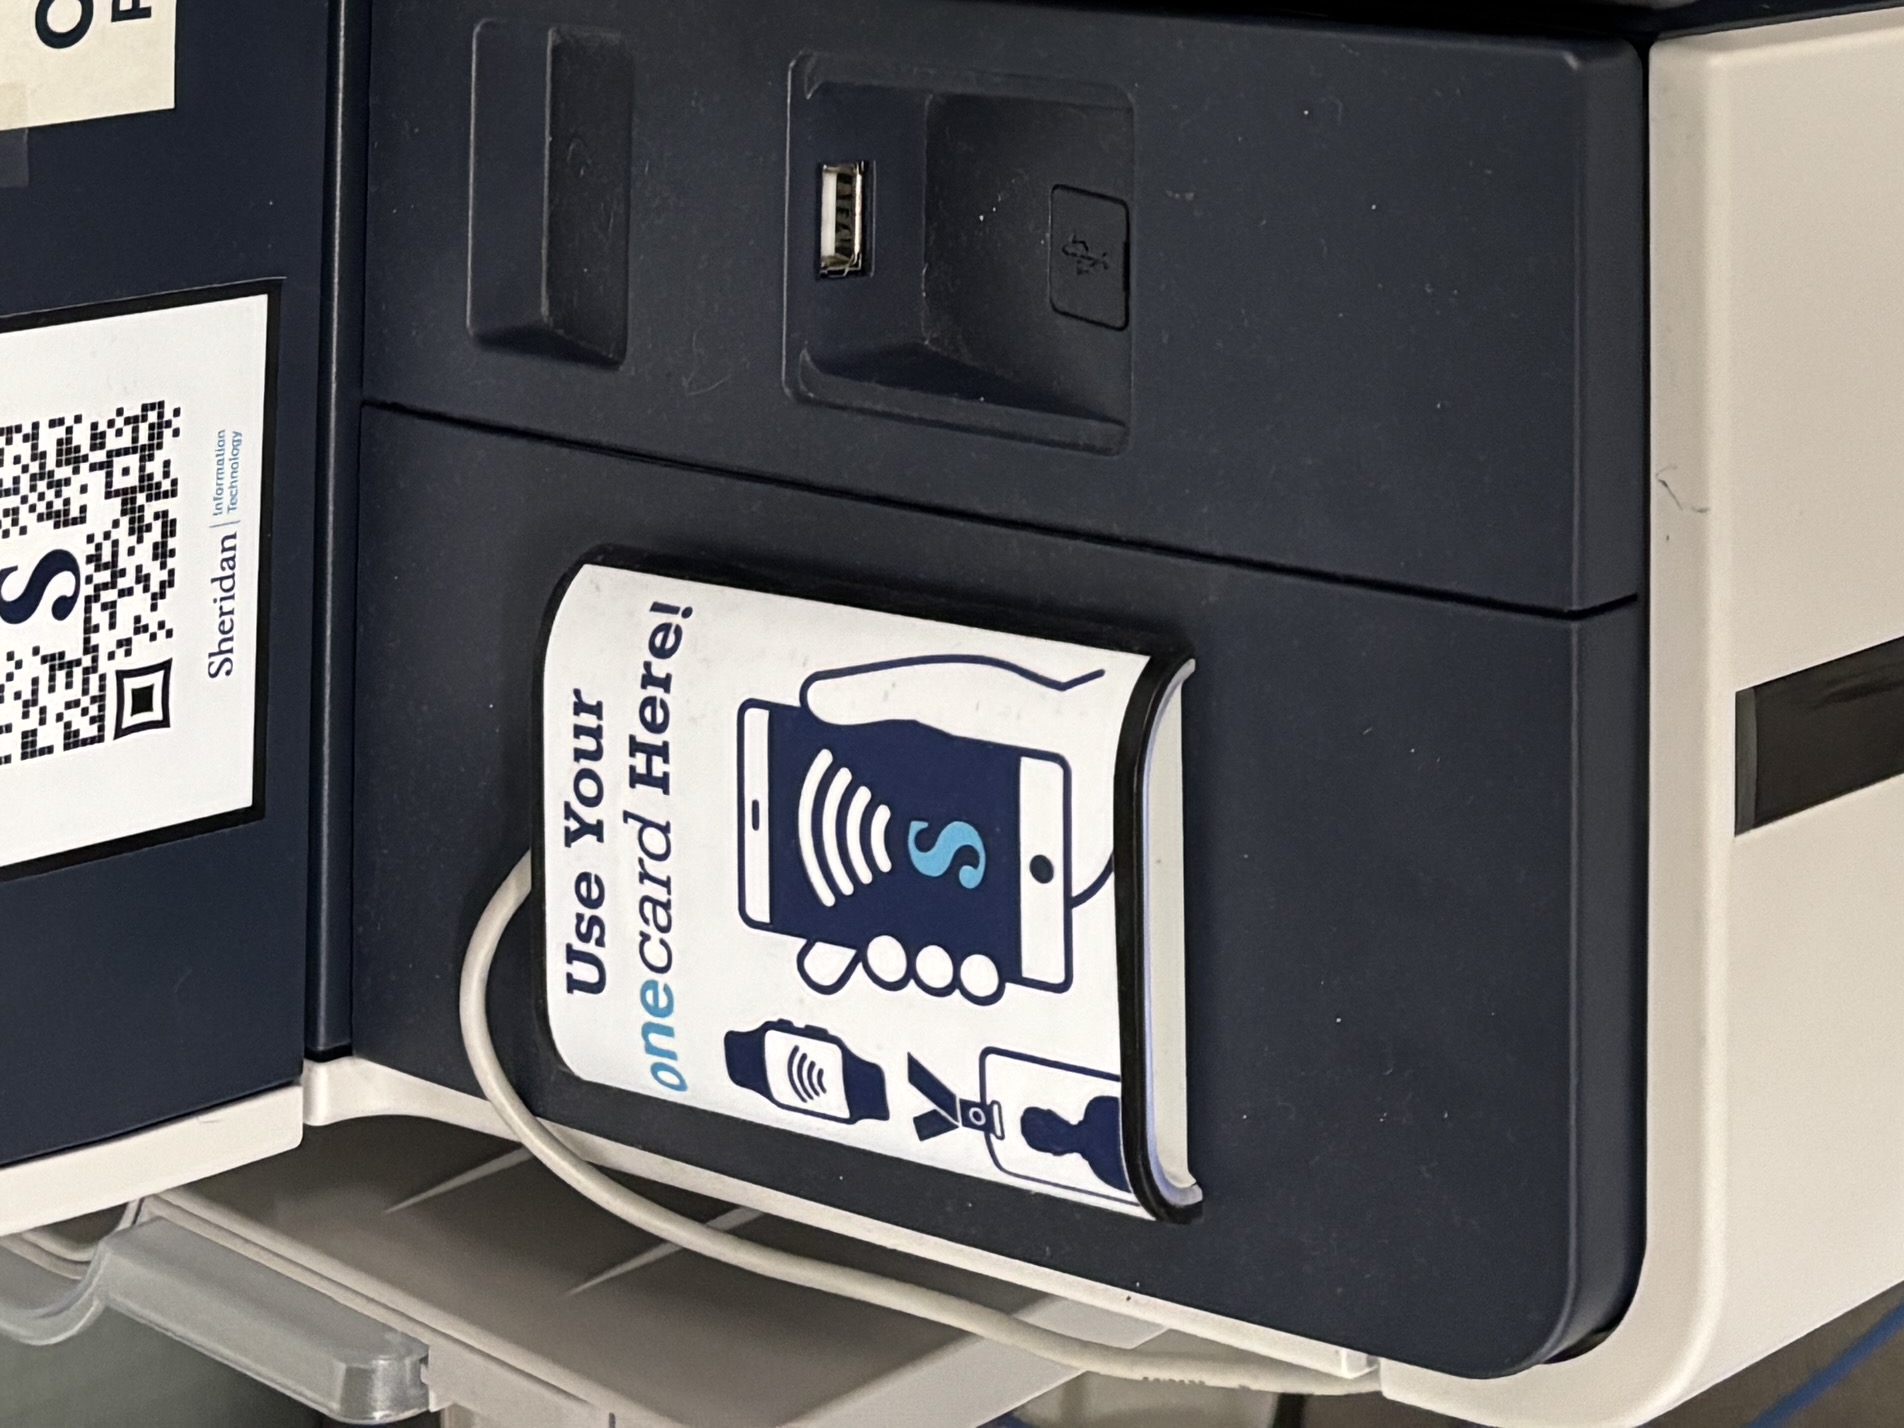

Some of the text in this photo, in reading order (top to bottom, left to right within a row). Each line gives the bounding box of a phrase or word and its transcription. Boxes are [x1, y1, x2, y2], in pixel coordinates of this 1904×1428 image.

[212, 429, 226, 516] Information
[227, 431, 242, 513] Technology
[207, 532, 239, 679] Sheridan
[565, 689, 607, 996] Use Your
[624, 599, 694, 1092] onecard Here!
